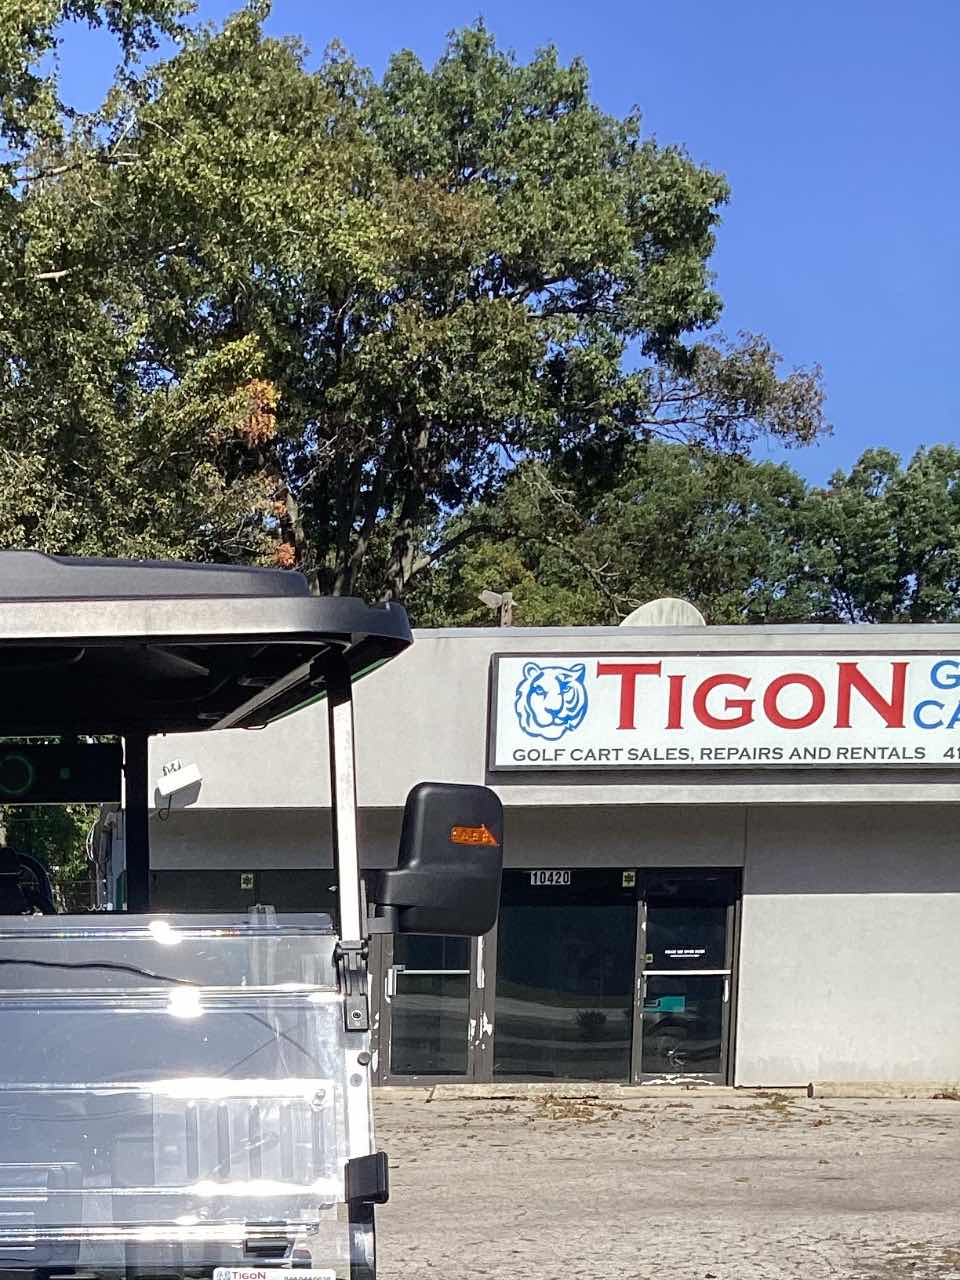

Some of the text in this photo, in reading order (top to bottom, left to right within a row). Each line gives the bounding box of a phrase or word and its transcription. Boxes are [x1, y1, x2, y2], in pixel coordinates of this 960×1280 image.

[596, 660, 909, 730] TIGON
[512, 748, 566, 762] GOLF
[570, 748, 624, 761] CART
[627, 747, 694, 763] SALES,
[700, 747, 784, 761] REPAIRS
[788, 747, 831, 760] AND
[836, 746, 926, 760] RENTALS
[531, 871, 570, 885] 10420
[232, 1271, 266, 1280] TIGON
